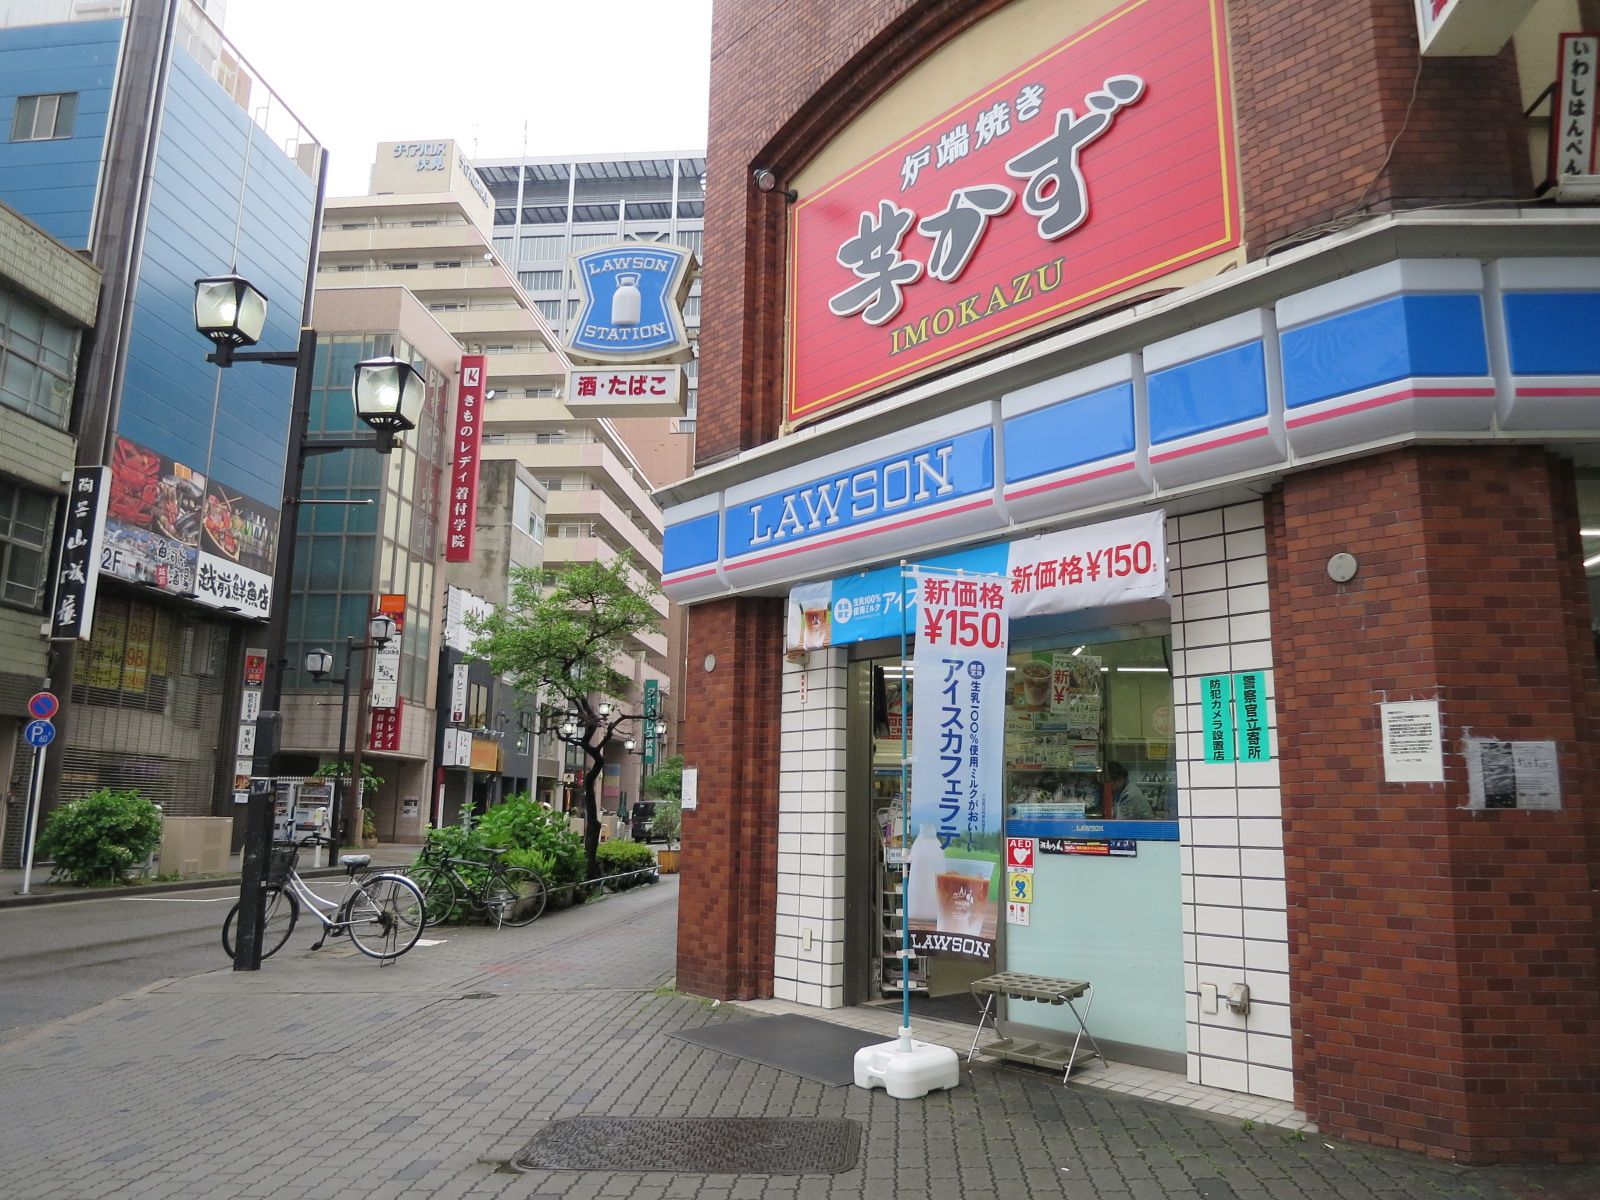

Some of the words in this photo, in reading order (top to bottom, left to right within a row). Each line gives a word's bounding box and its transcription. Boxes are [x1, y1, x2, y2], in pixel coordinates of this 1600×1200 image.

[900, 83, 1046, 192] 炉端焼き
[1564, 40, 1590, 175] いわしはんぺん
[828, 74, 1149, 326] 芋かず
[588, 256, 669, 275] LAWSON
[584, 322, 666, 342] STATION
[889, 257, 1065, 356] IMOKAZU
[451, 394, 475, 548] きものレディ着付学院
[748, 446, 954, 546] LAWSON
[101, 546, 123, 571] 2F
[199, 562, 269, 611] 越前鮮魚店
[924, 578, 1005, 610] 新価格
[924, 607, 1001, 649] ¥150
[32, 726, 43, 742] P
[1209, 679, 1225, 761] 防犯カメラ設置店
[1242, 675, 1262, 759] 警察官立寄所
[936, 658, 965, 850] アイスカフェラテ
[1010, 840, 1032, 848] AED
[911, 933, 991, 958] LAWSON
